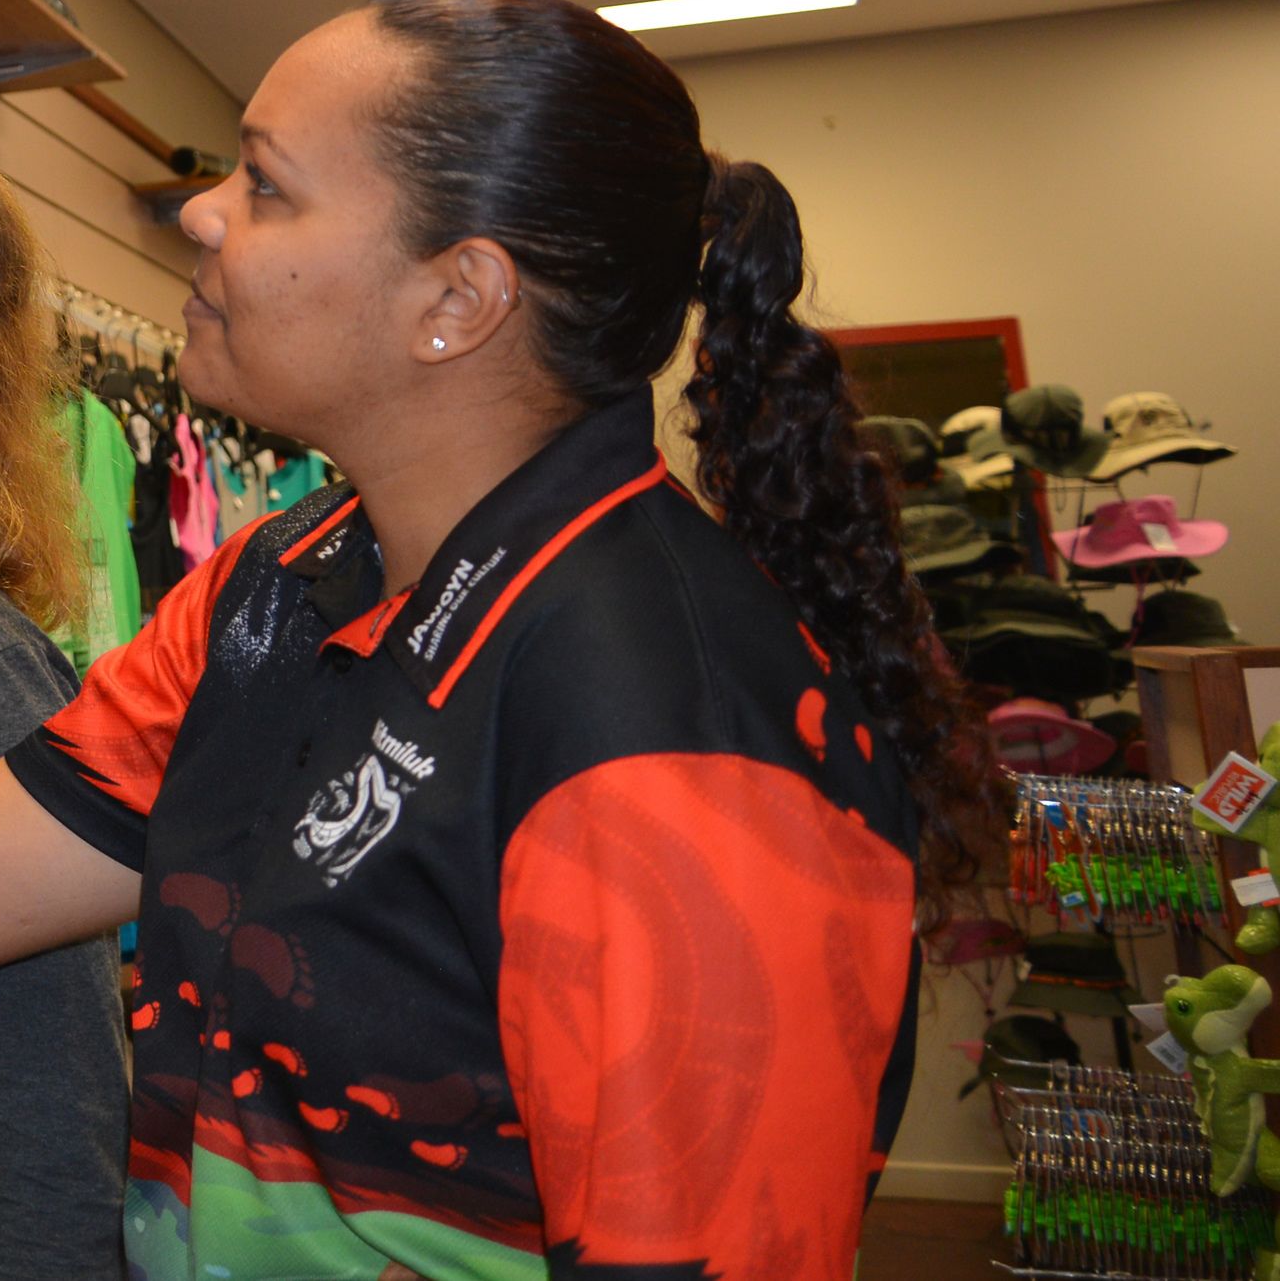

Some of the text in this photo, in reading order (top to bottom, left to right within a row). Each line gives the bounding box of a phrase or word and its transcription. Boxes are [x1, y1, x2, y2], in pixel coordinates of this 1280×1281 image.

[407, 558, 474, 655] JAWOYN
[424, 546, 508, 663] SHARING OUR CULTURE
[1218, 773, 1259, 817] WILD
